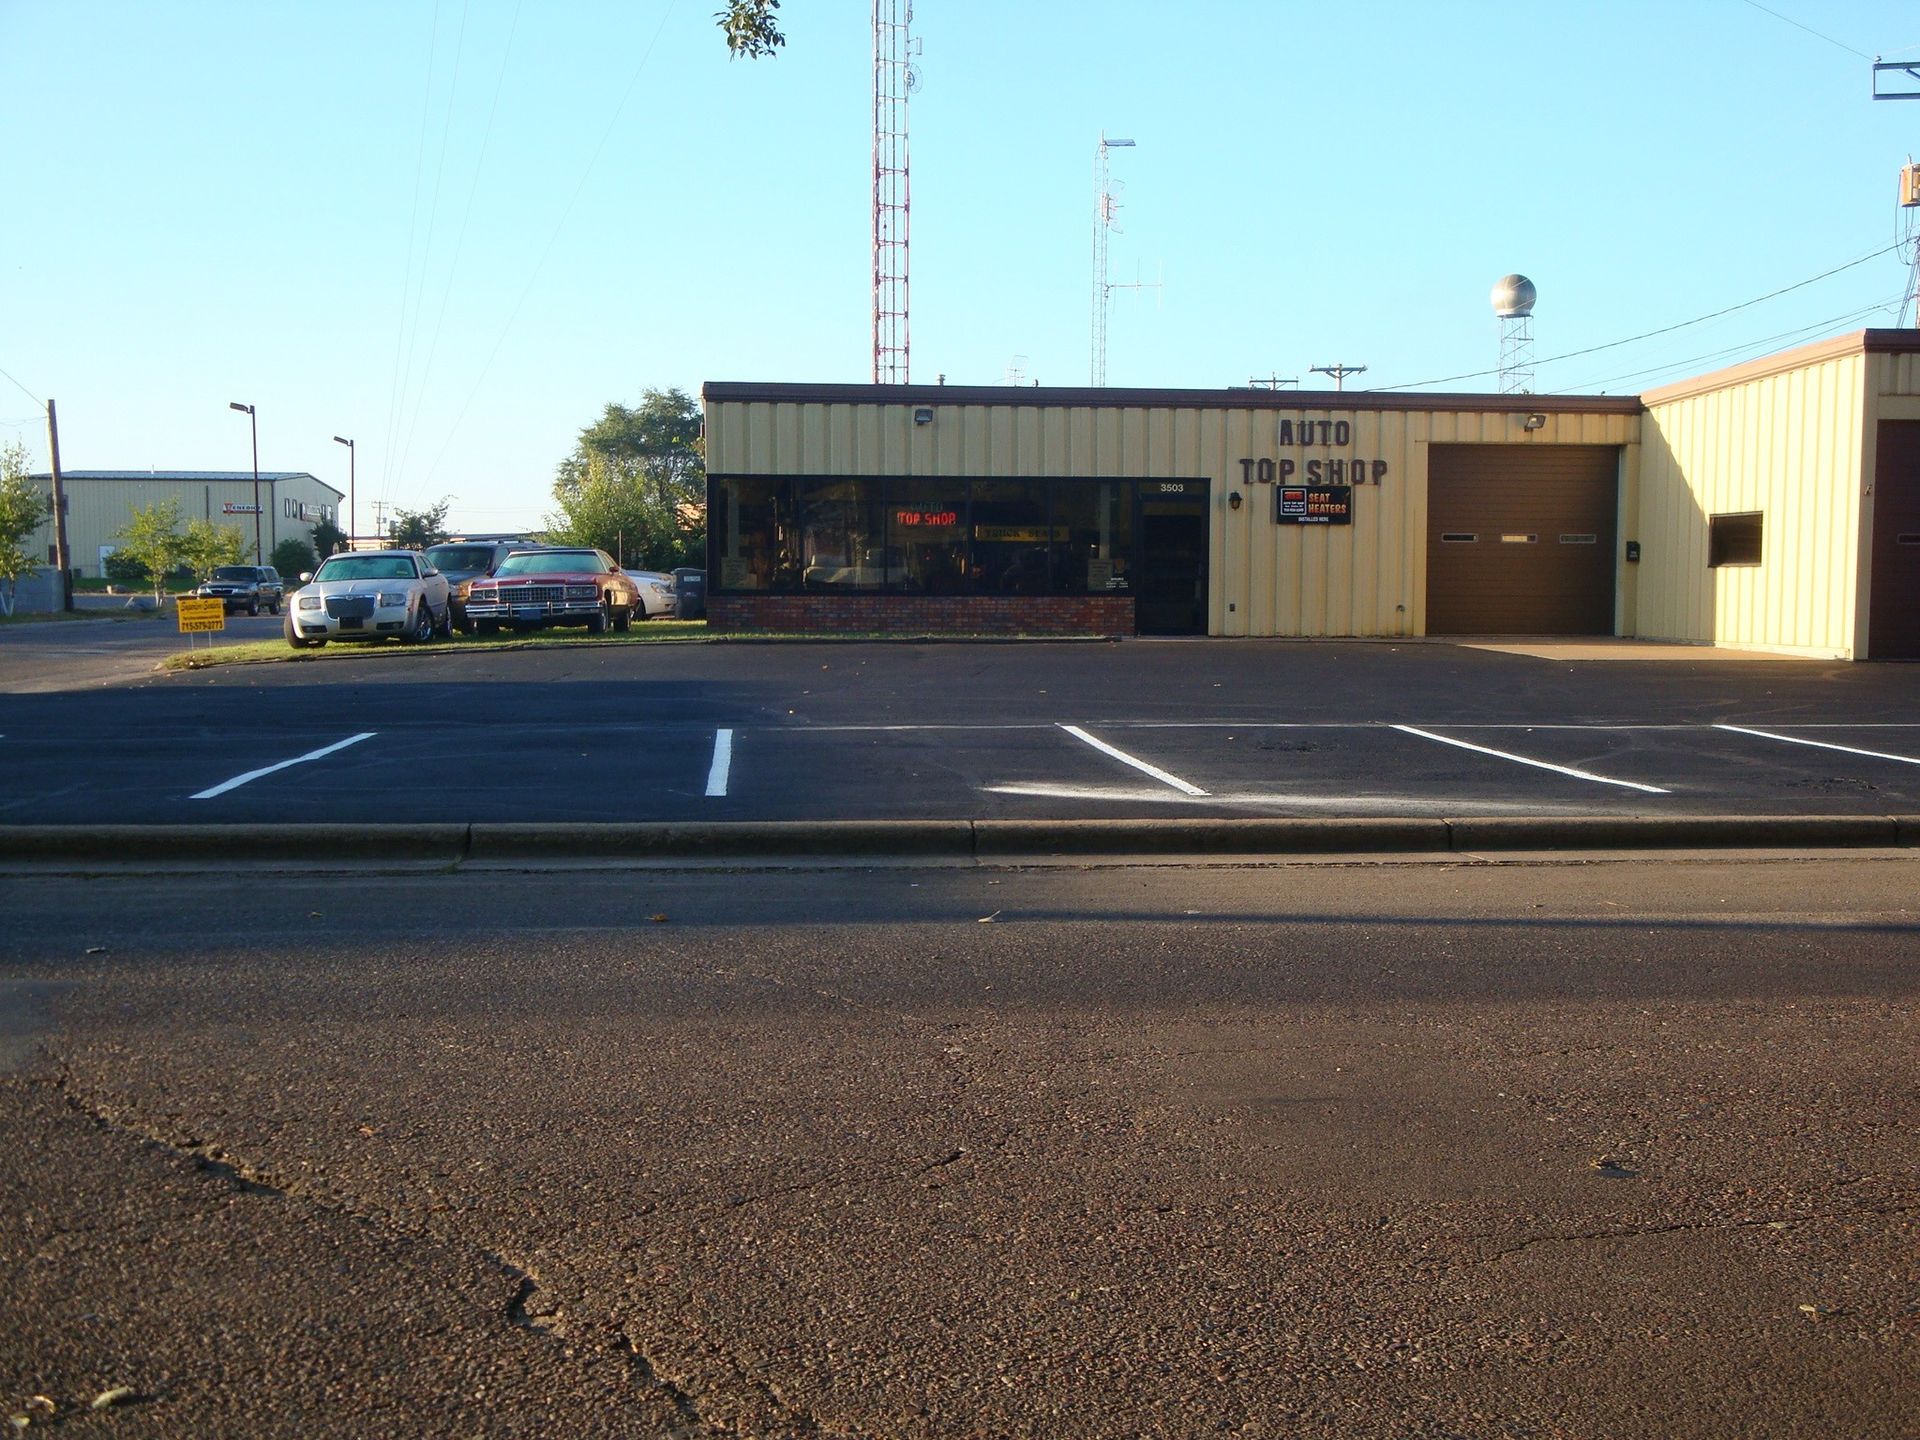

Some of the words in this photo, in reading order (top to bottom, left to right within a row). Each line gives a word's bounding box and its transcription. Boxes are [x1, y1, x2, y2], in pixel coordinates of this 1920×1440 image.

[1280, 420, 1349, 446] AUTO
[1240, 458, 1295, 485] TOP
[1307, 459, 1388, 485] SHOP
[1160, 483, 1184, 492] 3503
[1308, 493, 1330, 503] SEAT
[1308, 504, 1347, 514] HEATERS
[898, 511, 921, 524] TOP
[924, 511, 957, 524] SHOP
[985, 528, 1019, 538] TRUCK
[1028, 528, 1061, 538] SEAS
